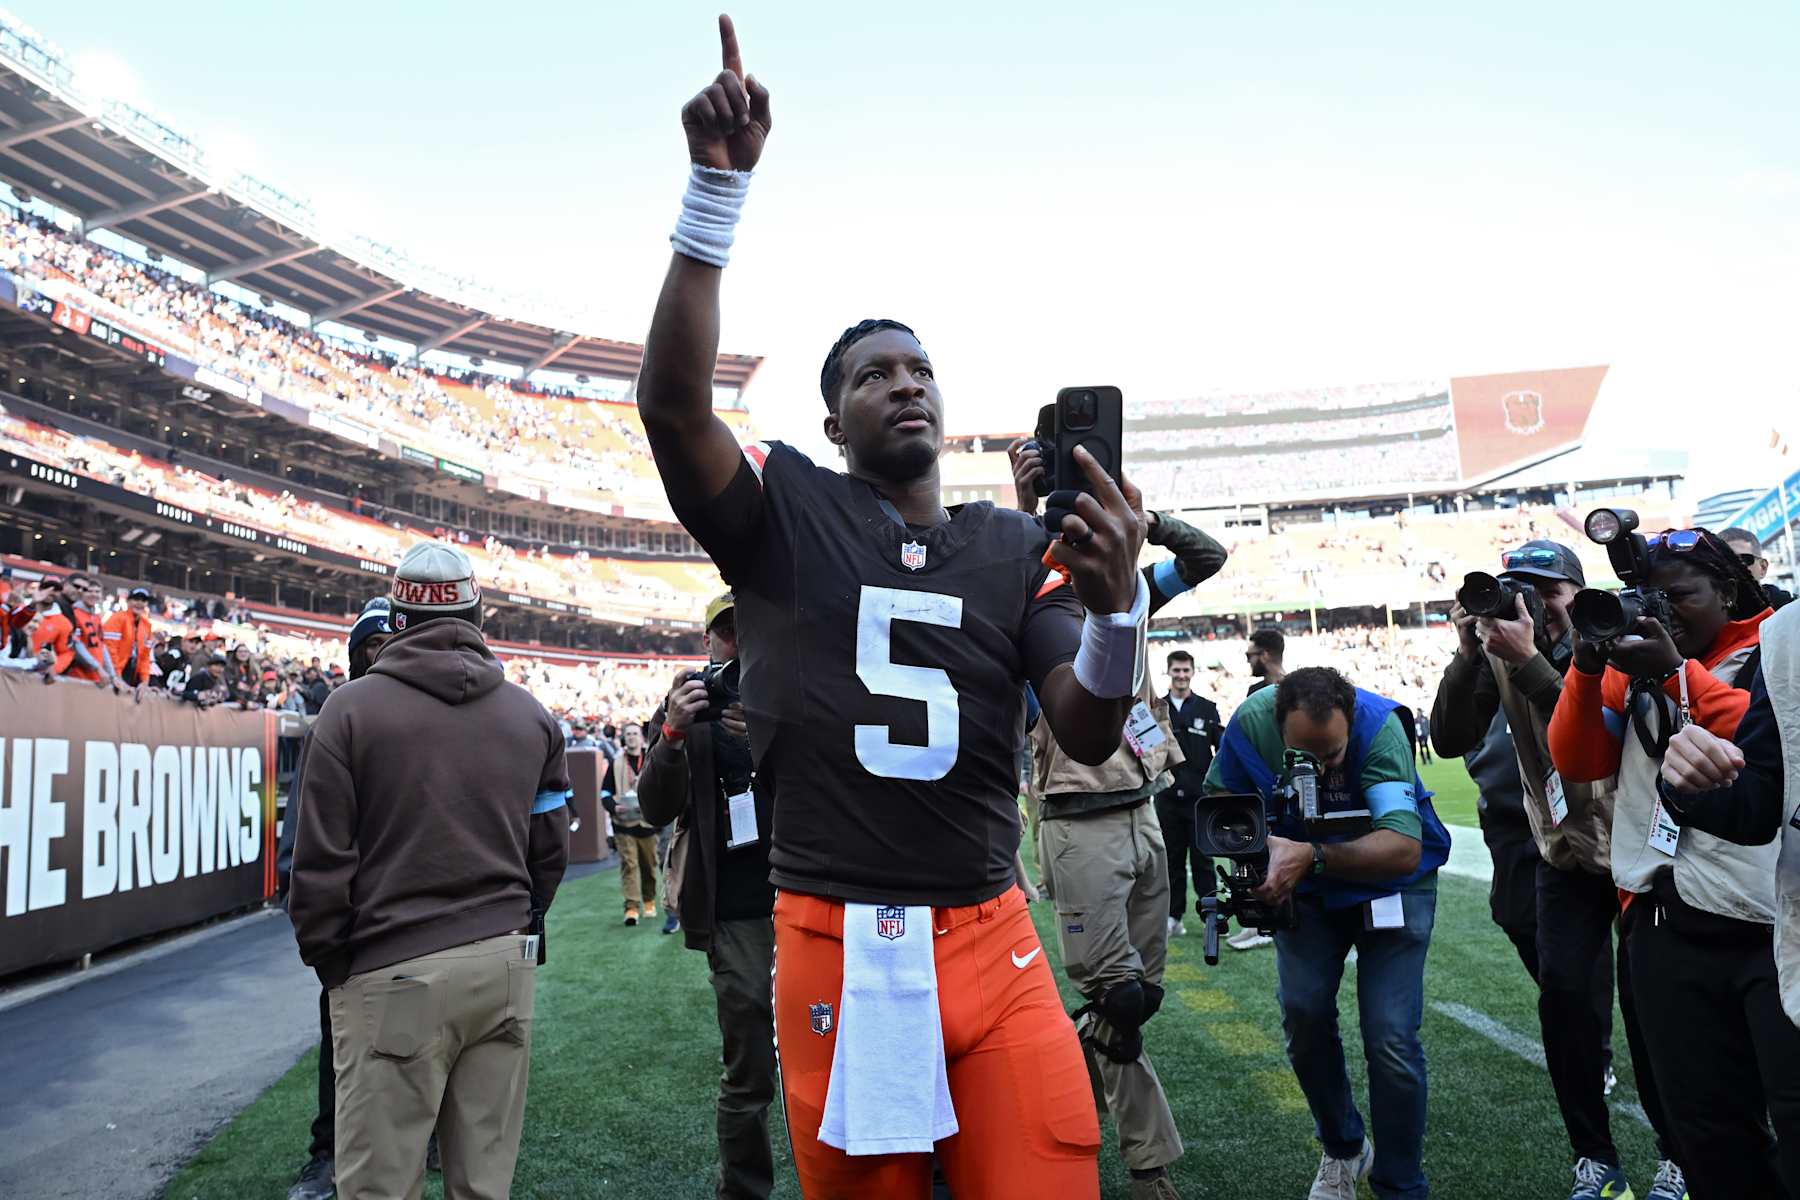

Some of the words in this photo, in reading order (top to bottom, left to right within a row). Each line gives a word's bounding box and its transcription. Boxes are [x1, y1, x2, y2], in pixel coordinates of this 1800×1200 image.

[855, 585, 963, 781] 5
[82, 740, 262, 900] BROWNS
[879, 920, 903, 936] NFL
